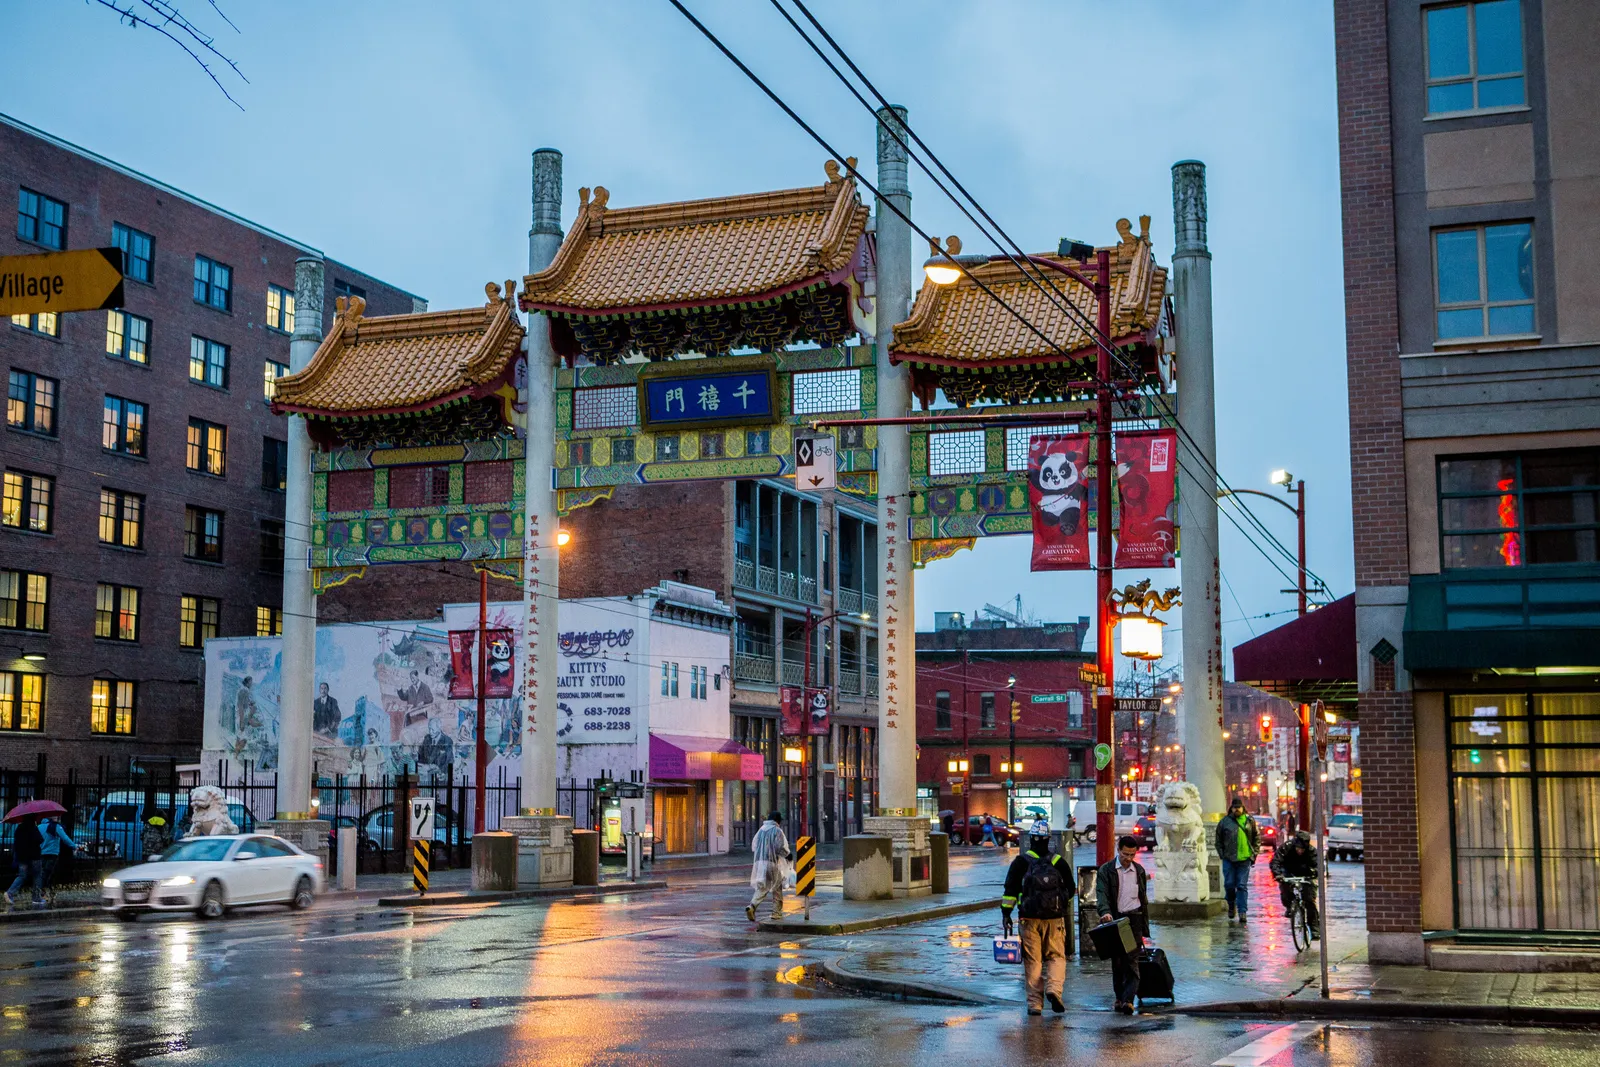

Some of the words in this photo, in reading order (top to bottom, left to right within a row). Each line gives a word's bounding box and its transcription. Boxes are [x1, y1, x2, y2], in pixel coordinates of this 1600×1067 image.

[0, 273, 64, 304] Village
[665, 380, 756, 413] 千禧門
[569, 661, 607, 674] KITTY'S
[557, 675, 585, 688] EAUTY
[590, 675, 626, 688] STUDIO
[580, 691, 591, 699] SKIN
[591, 691, 603, 699] CARE
[1119, 700, 1146, 710] TAYLOR
[584, 706, 631, 716] 683-7028
[584, 721, 631, 731] 688-2238
